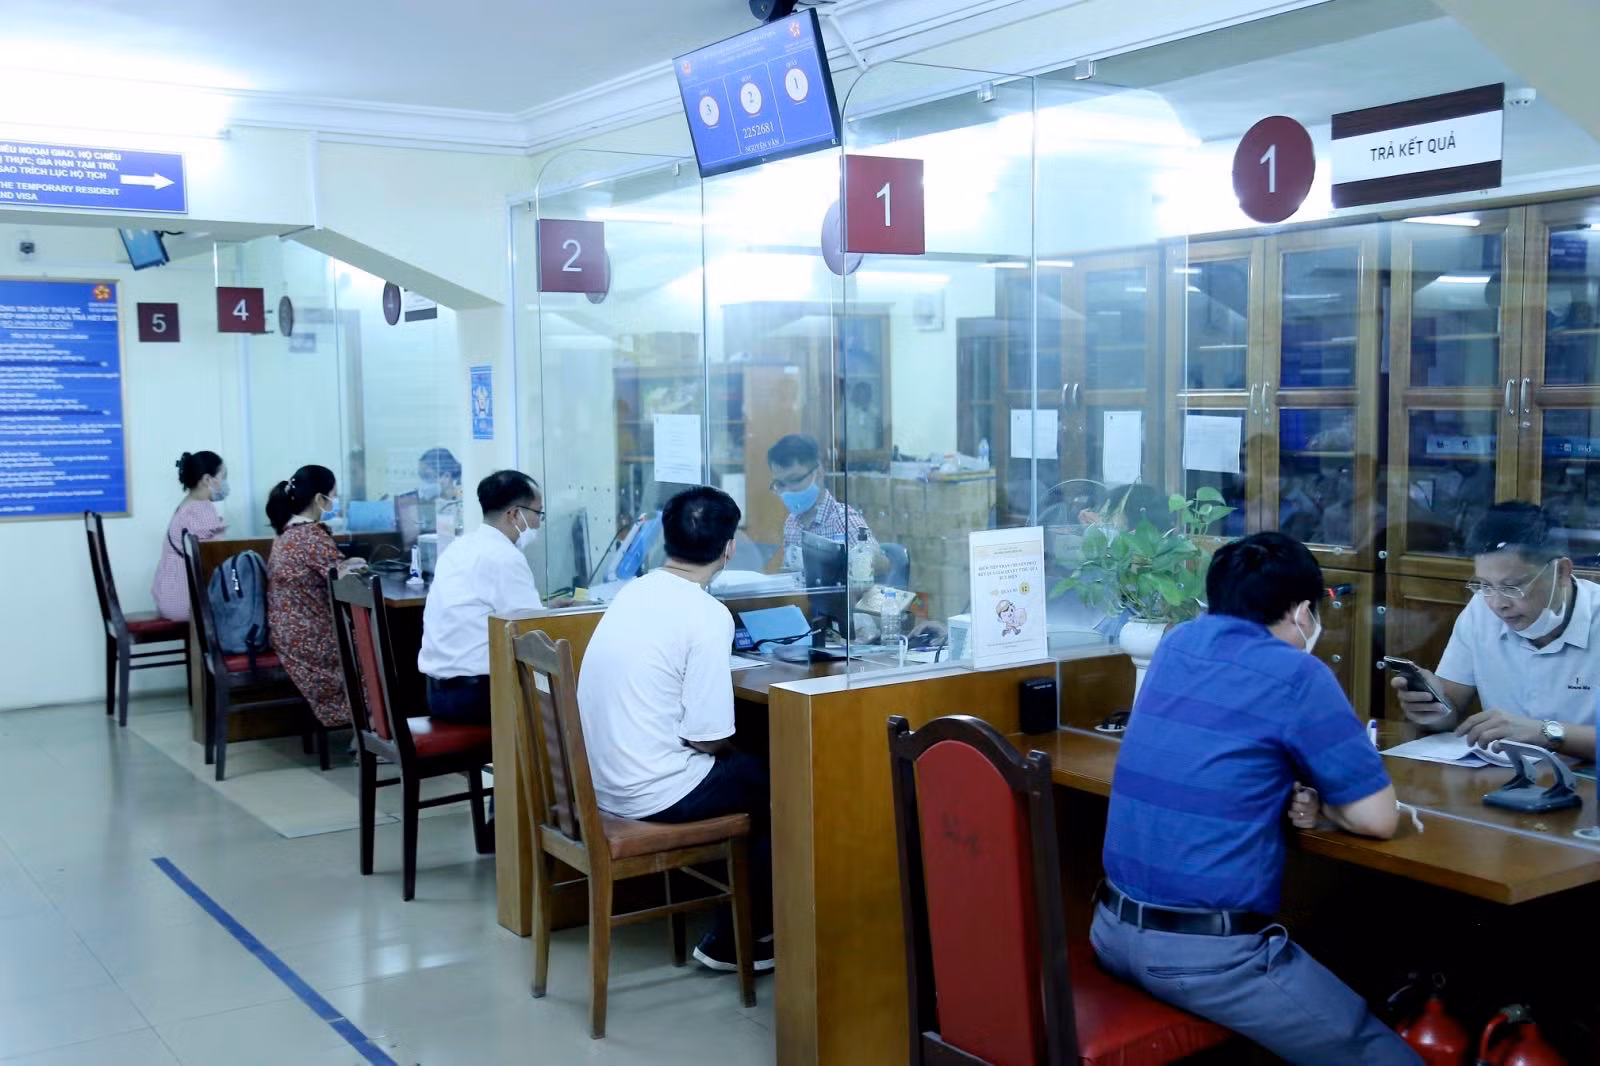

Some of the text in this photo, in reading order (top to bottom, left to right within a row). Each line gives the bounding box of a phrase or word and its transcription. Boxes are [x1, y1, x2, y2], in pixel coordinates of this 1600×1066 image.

[747, 91, 754, 104] 2
[706, 104, 712, 116] 3
[742, 121, 774, 139] 2252681
[18, 147, 49, 156] NGOẠI
[78, 150, 93, 160] HỘ
[1370, 130, 1457, 162] TRẢ KẾT QUẢ
[36, 158, 53, 166] GIA
[54, 159, 74, 168] HẠN
[76, 161, 96, 170] TẠM
[1258, 143, 1277, 194] 1
[19, 166, 48, 175] TRÍCH
[49, 169, 69, 178] LỤC
[70, 169, 85, 180] HỘ
[85, 170, 107, 180] TỊCH
[15, 182, 74, 192] TEMPORARY
[75, 186, 120, 195] RESIDENT
[15, 192, 38, 201] VISA
[875, 182, 892, 228] 1
[561, 239, 583, 273] 2
[232, 299, 249, 321] 4
[152, 313, 167, 333] 5
